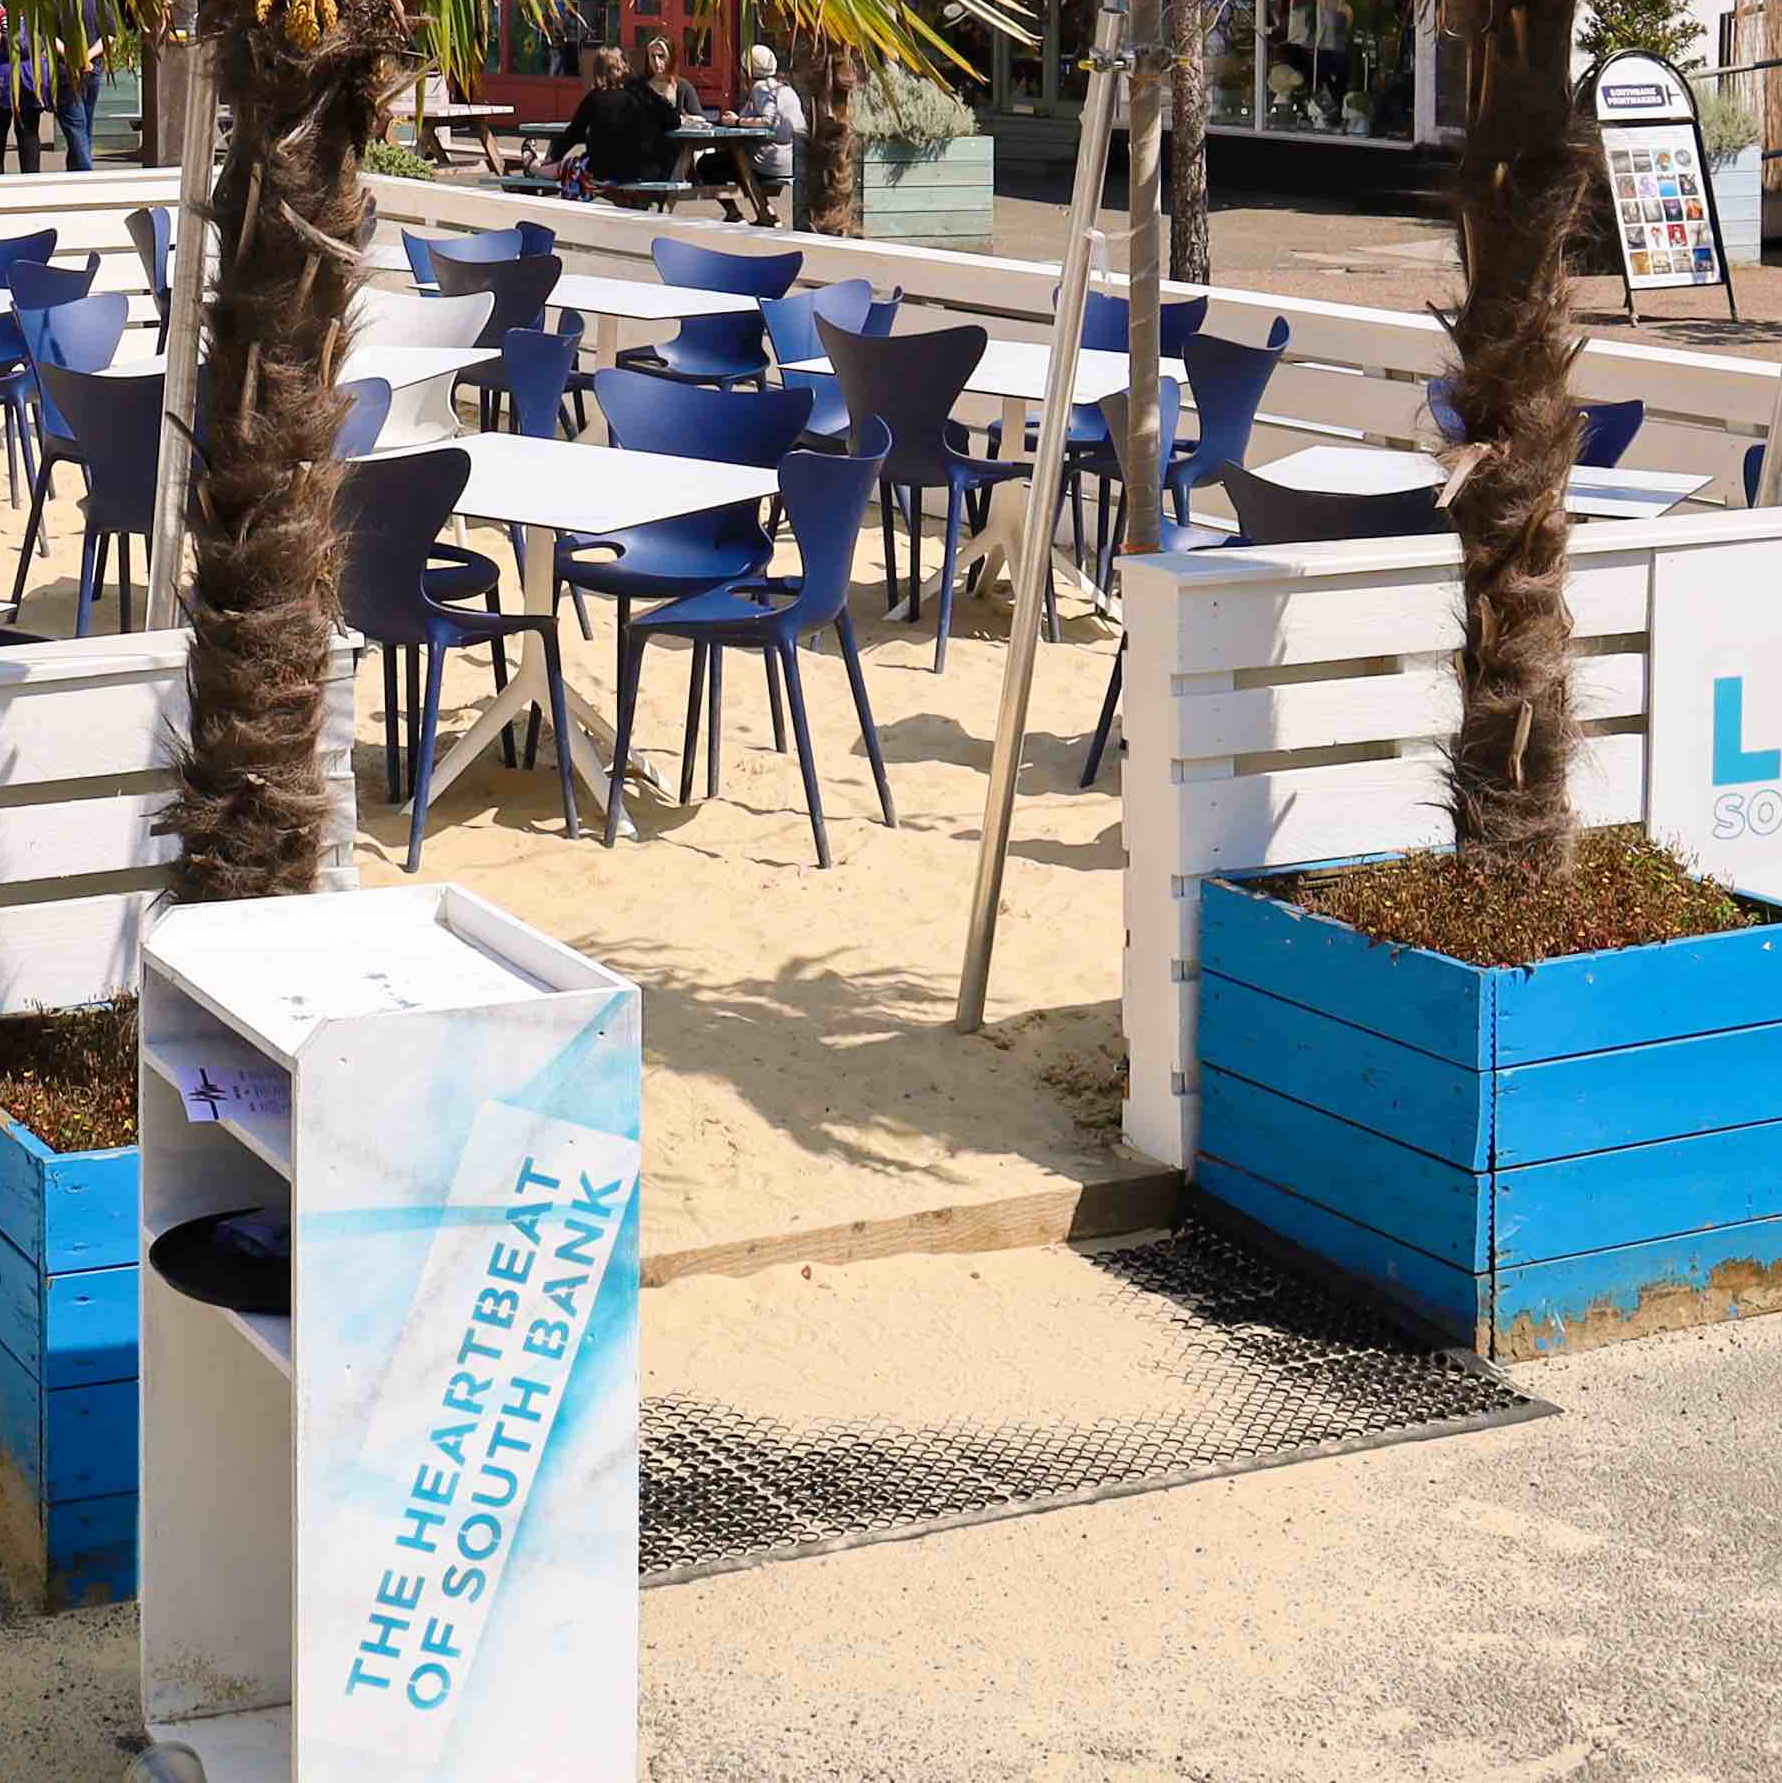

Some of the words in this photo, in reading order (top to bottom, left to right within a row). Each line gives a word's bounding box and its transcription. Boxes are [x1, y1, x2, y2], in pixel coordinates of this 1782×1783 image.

[345, 1568, 426, 1697] THE
[393, 1156, 562, 1555] HEARTBEAT
[406, 1615, 462, 1711] OF
[441, 1376, 552, 1605] SOUTH
[522, 1169, 623, 1361] BANK
